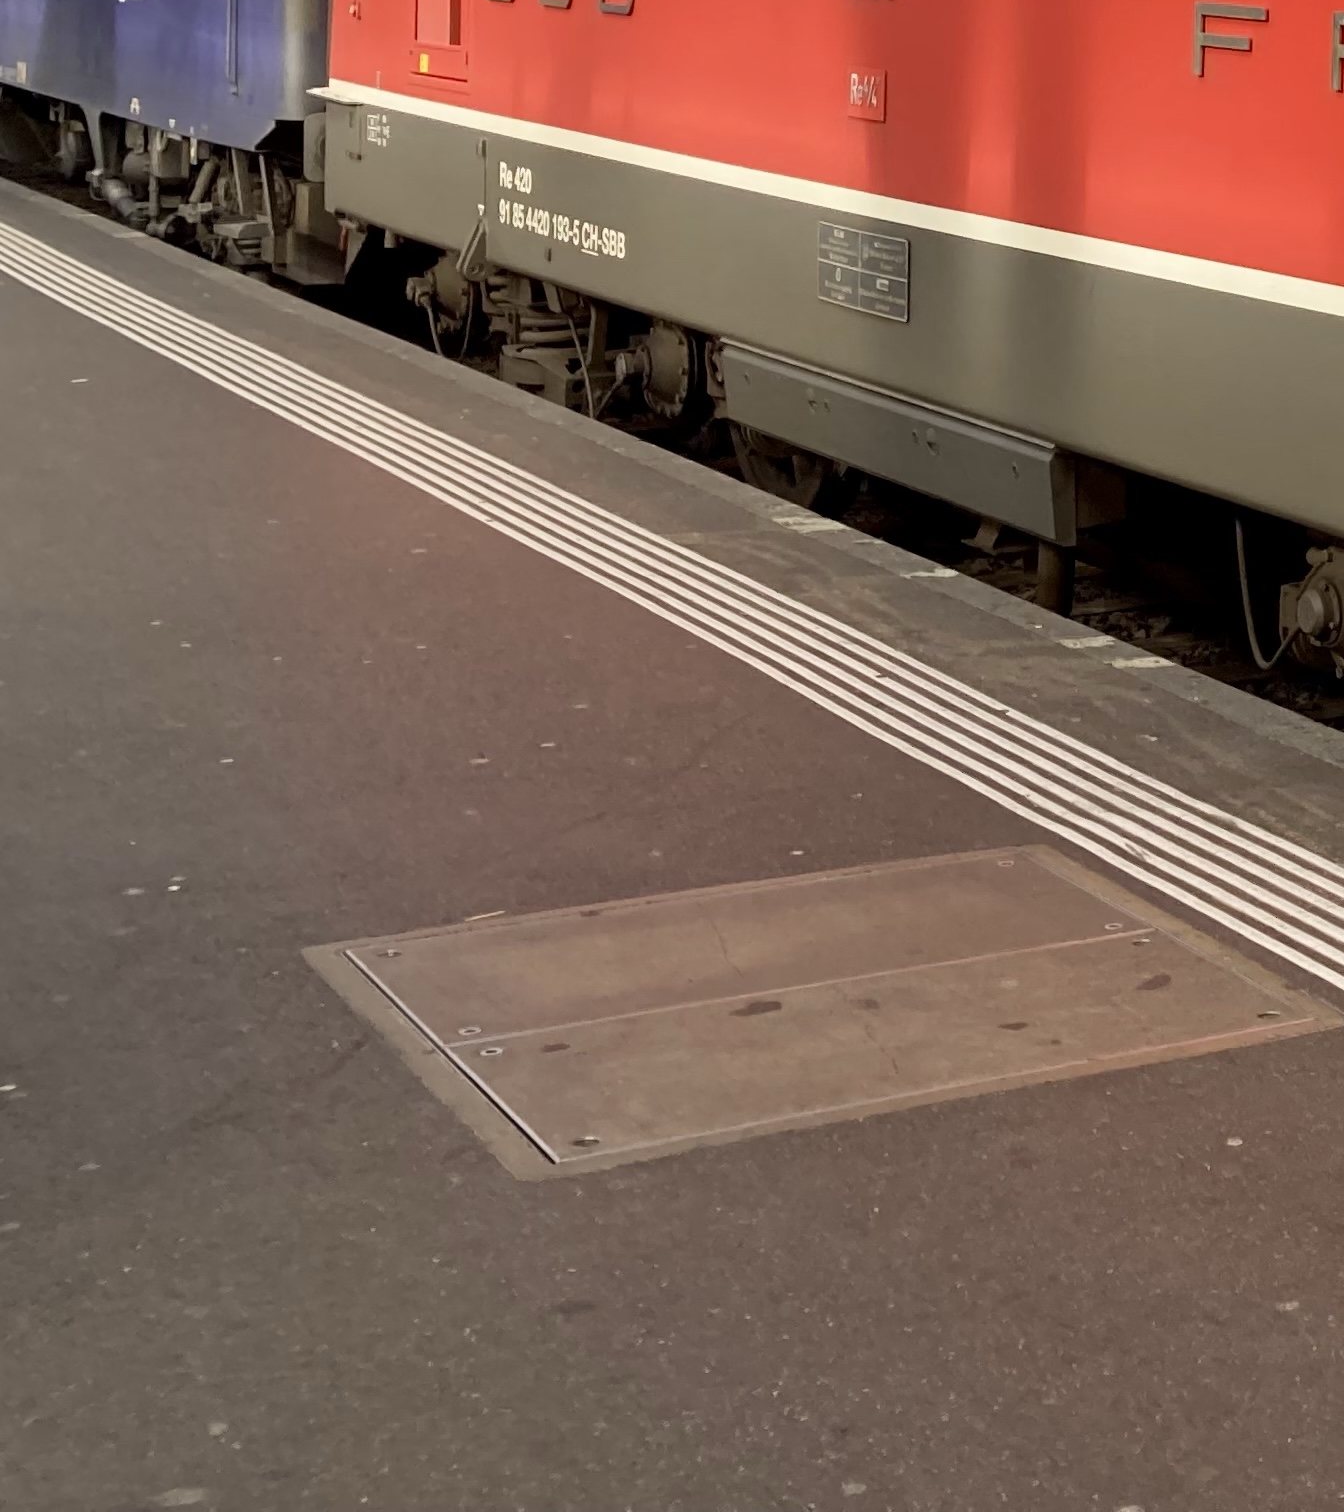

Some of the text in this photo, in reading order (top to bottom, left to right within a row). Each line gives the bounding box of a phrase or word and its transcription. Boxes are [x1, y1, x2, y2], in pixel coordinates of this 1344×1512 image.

[499, 161, 533, 195] Re 420
[499, 198, 626, 259] 91 85 4420 193-5 CH-SBB
